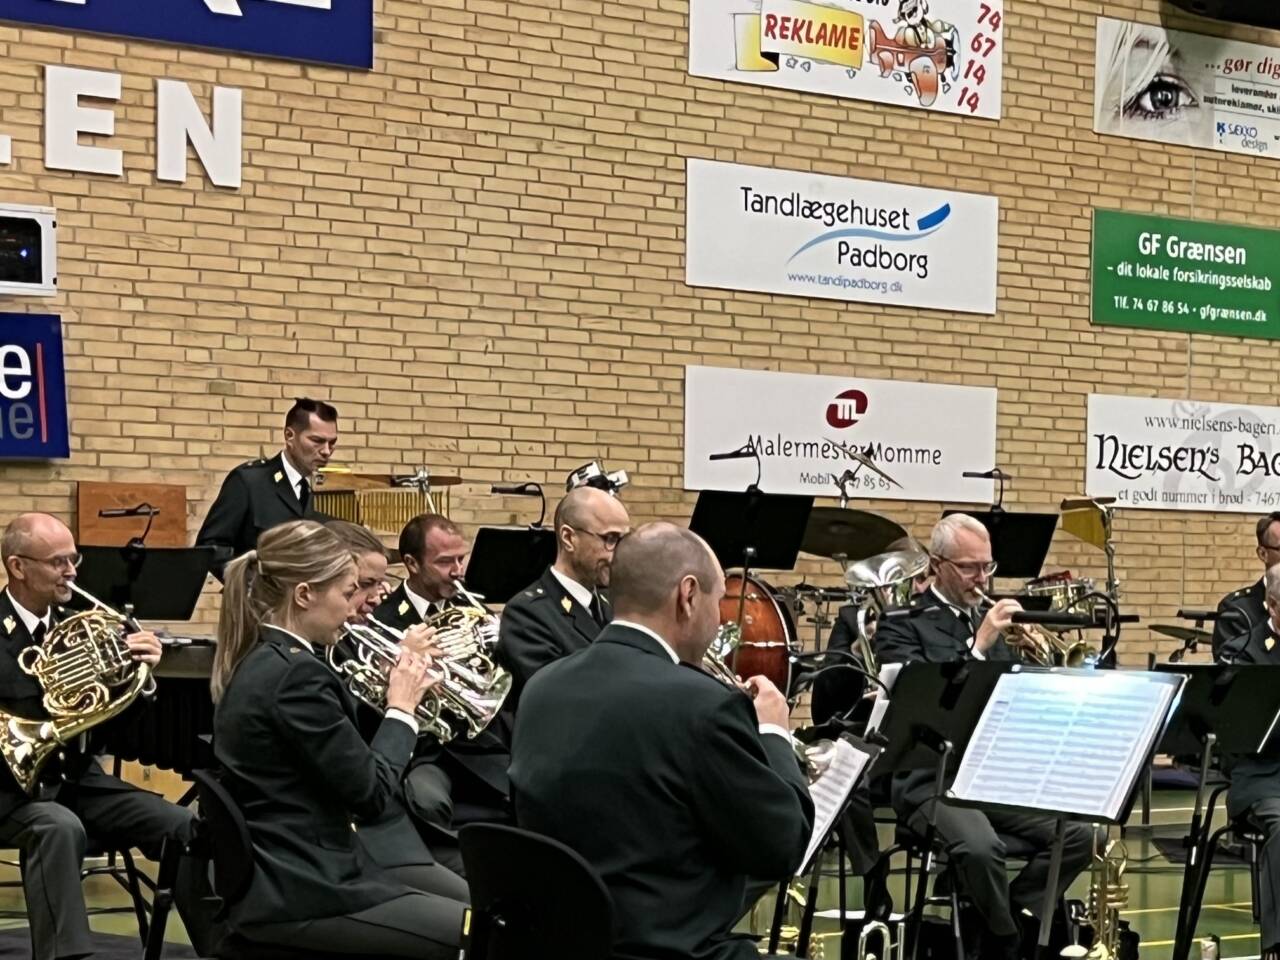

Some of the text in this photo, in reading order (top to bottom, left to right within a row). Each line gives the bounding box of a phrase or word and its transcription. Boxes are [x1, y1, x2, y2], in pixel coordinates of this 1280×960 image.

[764, 13, 860, 50] REKLAME
[976, 3, 1001, 32] 74
[970, 32, 996, 58] 67
[963, 59, 986, 85] 14
[957, 86, 980, 113] 14
[0, 64, 242, 188] EN
[740, 187, 910, 231] Tandlægehuset
[838, 241, 928, 279] Padborg
[1138, 232, 1246, 265] GF Grænsen
[1136, 262, 1169, 281] lokale
[1132, 297, 1144, 311] 74
[1147, 298, 1159, 312] 67
[1162, 300, 1174, 314] 86
[747, 433, 942, 465] Malermester Momme
[800, 472, 830, 485] Mobil
[1118, 489, 1129, 501] et
[1132, 488, 1157, 504] godt
[1162, 492, 1208, 505] nummer
[1255, 491, 1280, 506] 7467
